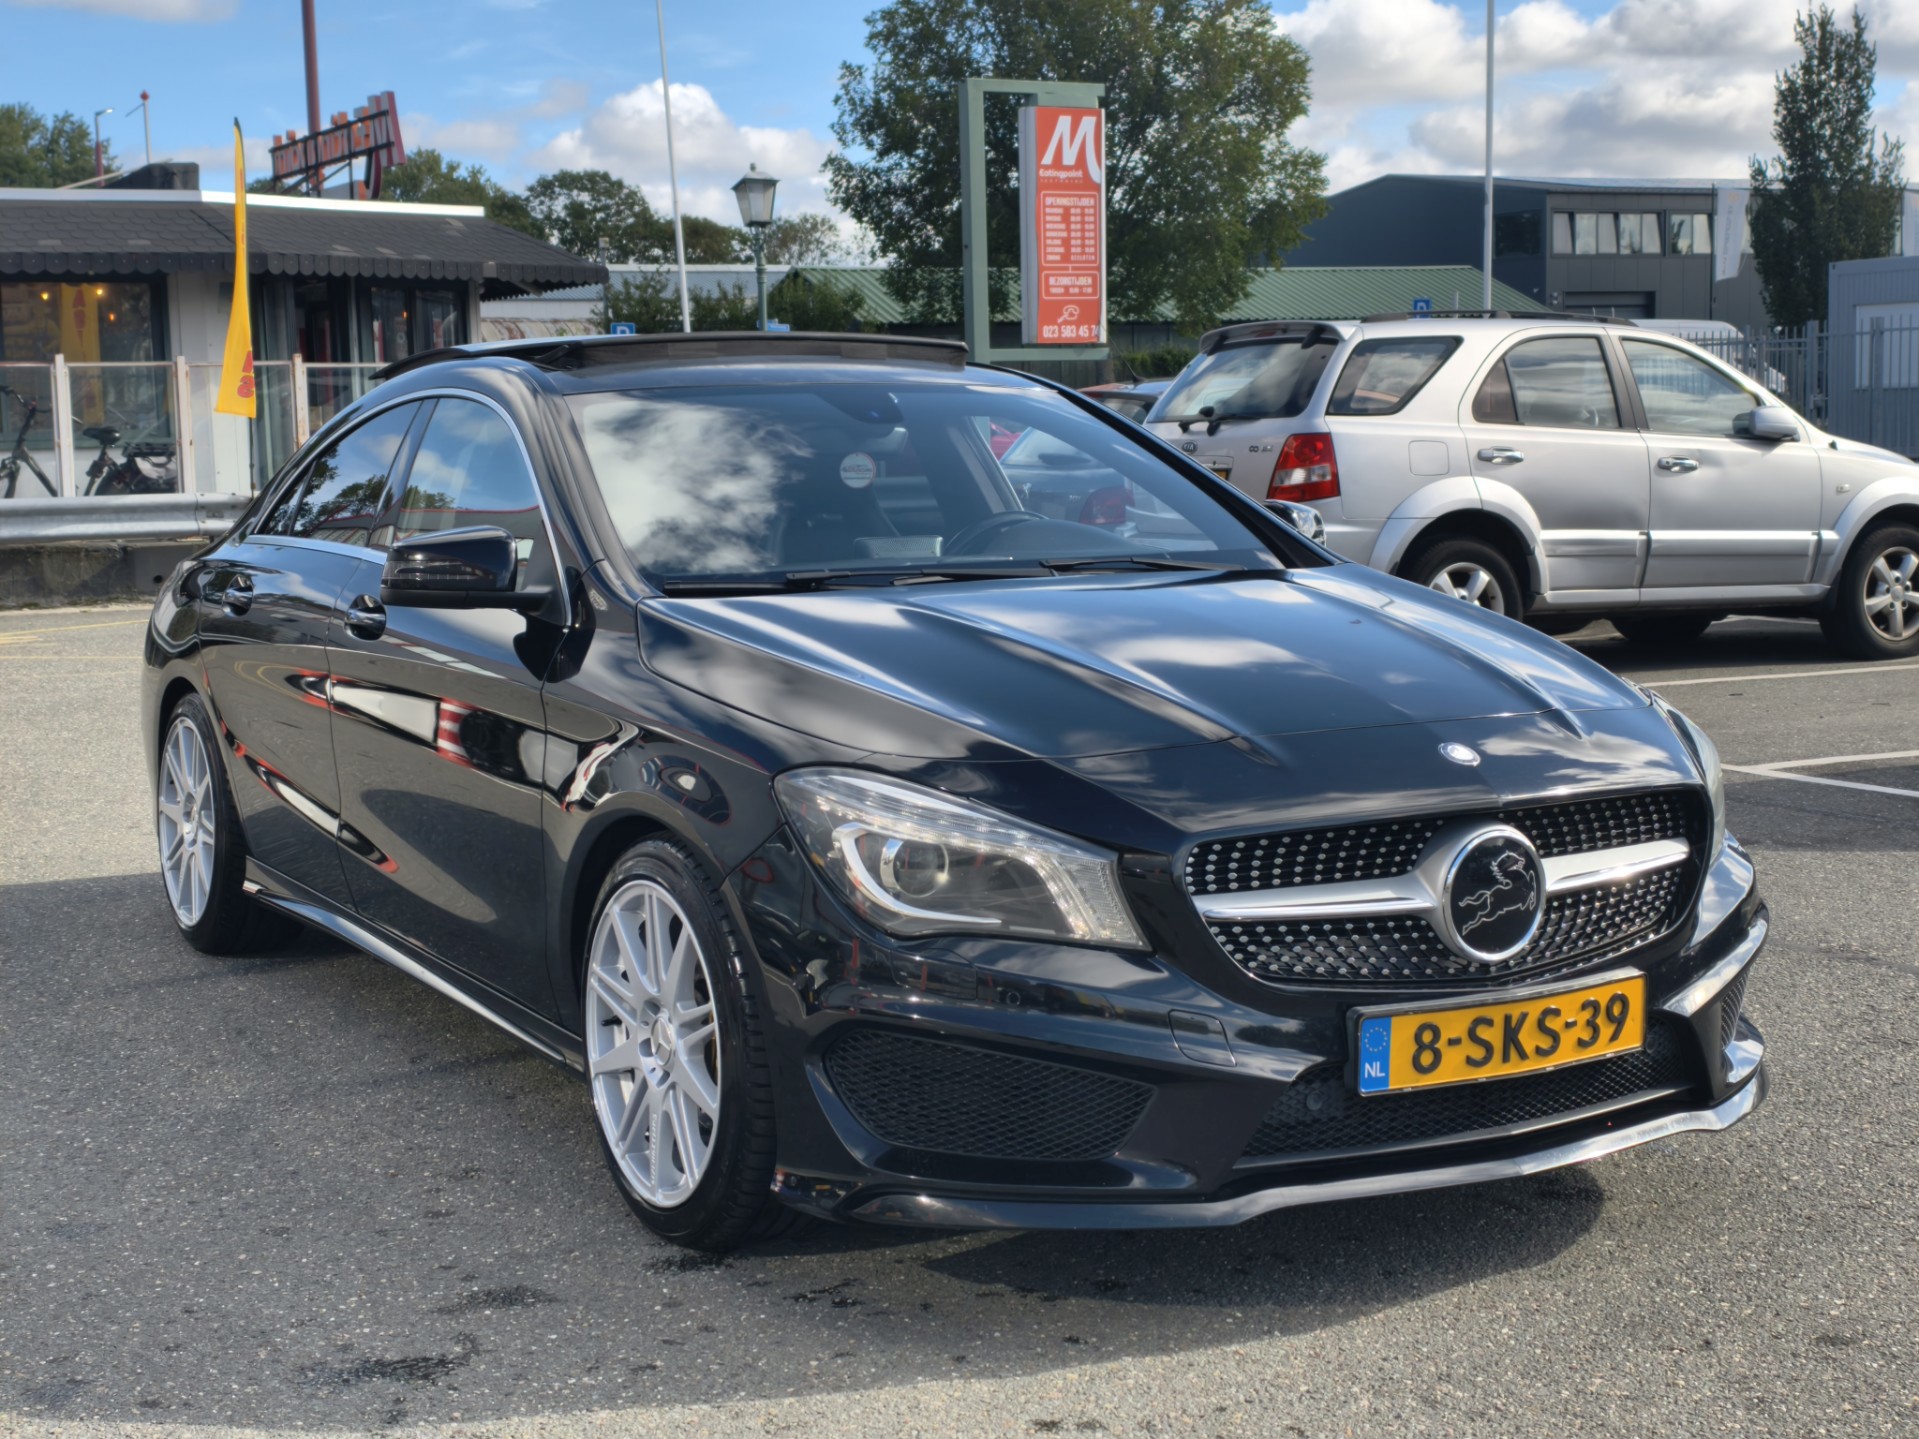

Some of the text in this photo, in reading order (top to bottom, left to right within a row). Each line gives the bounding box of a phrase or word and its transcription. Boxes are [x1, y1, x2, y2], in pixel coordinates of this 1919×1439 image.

[1040, 115, 1101, 184] M
[1043, 325, 1058, 338] 023
[1078, 325, 1089, 338] 45
[1411, 991, 1630, 1075] 8-SKS-39
[1364, 1060, 1385, 1079] NL
